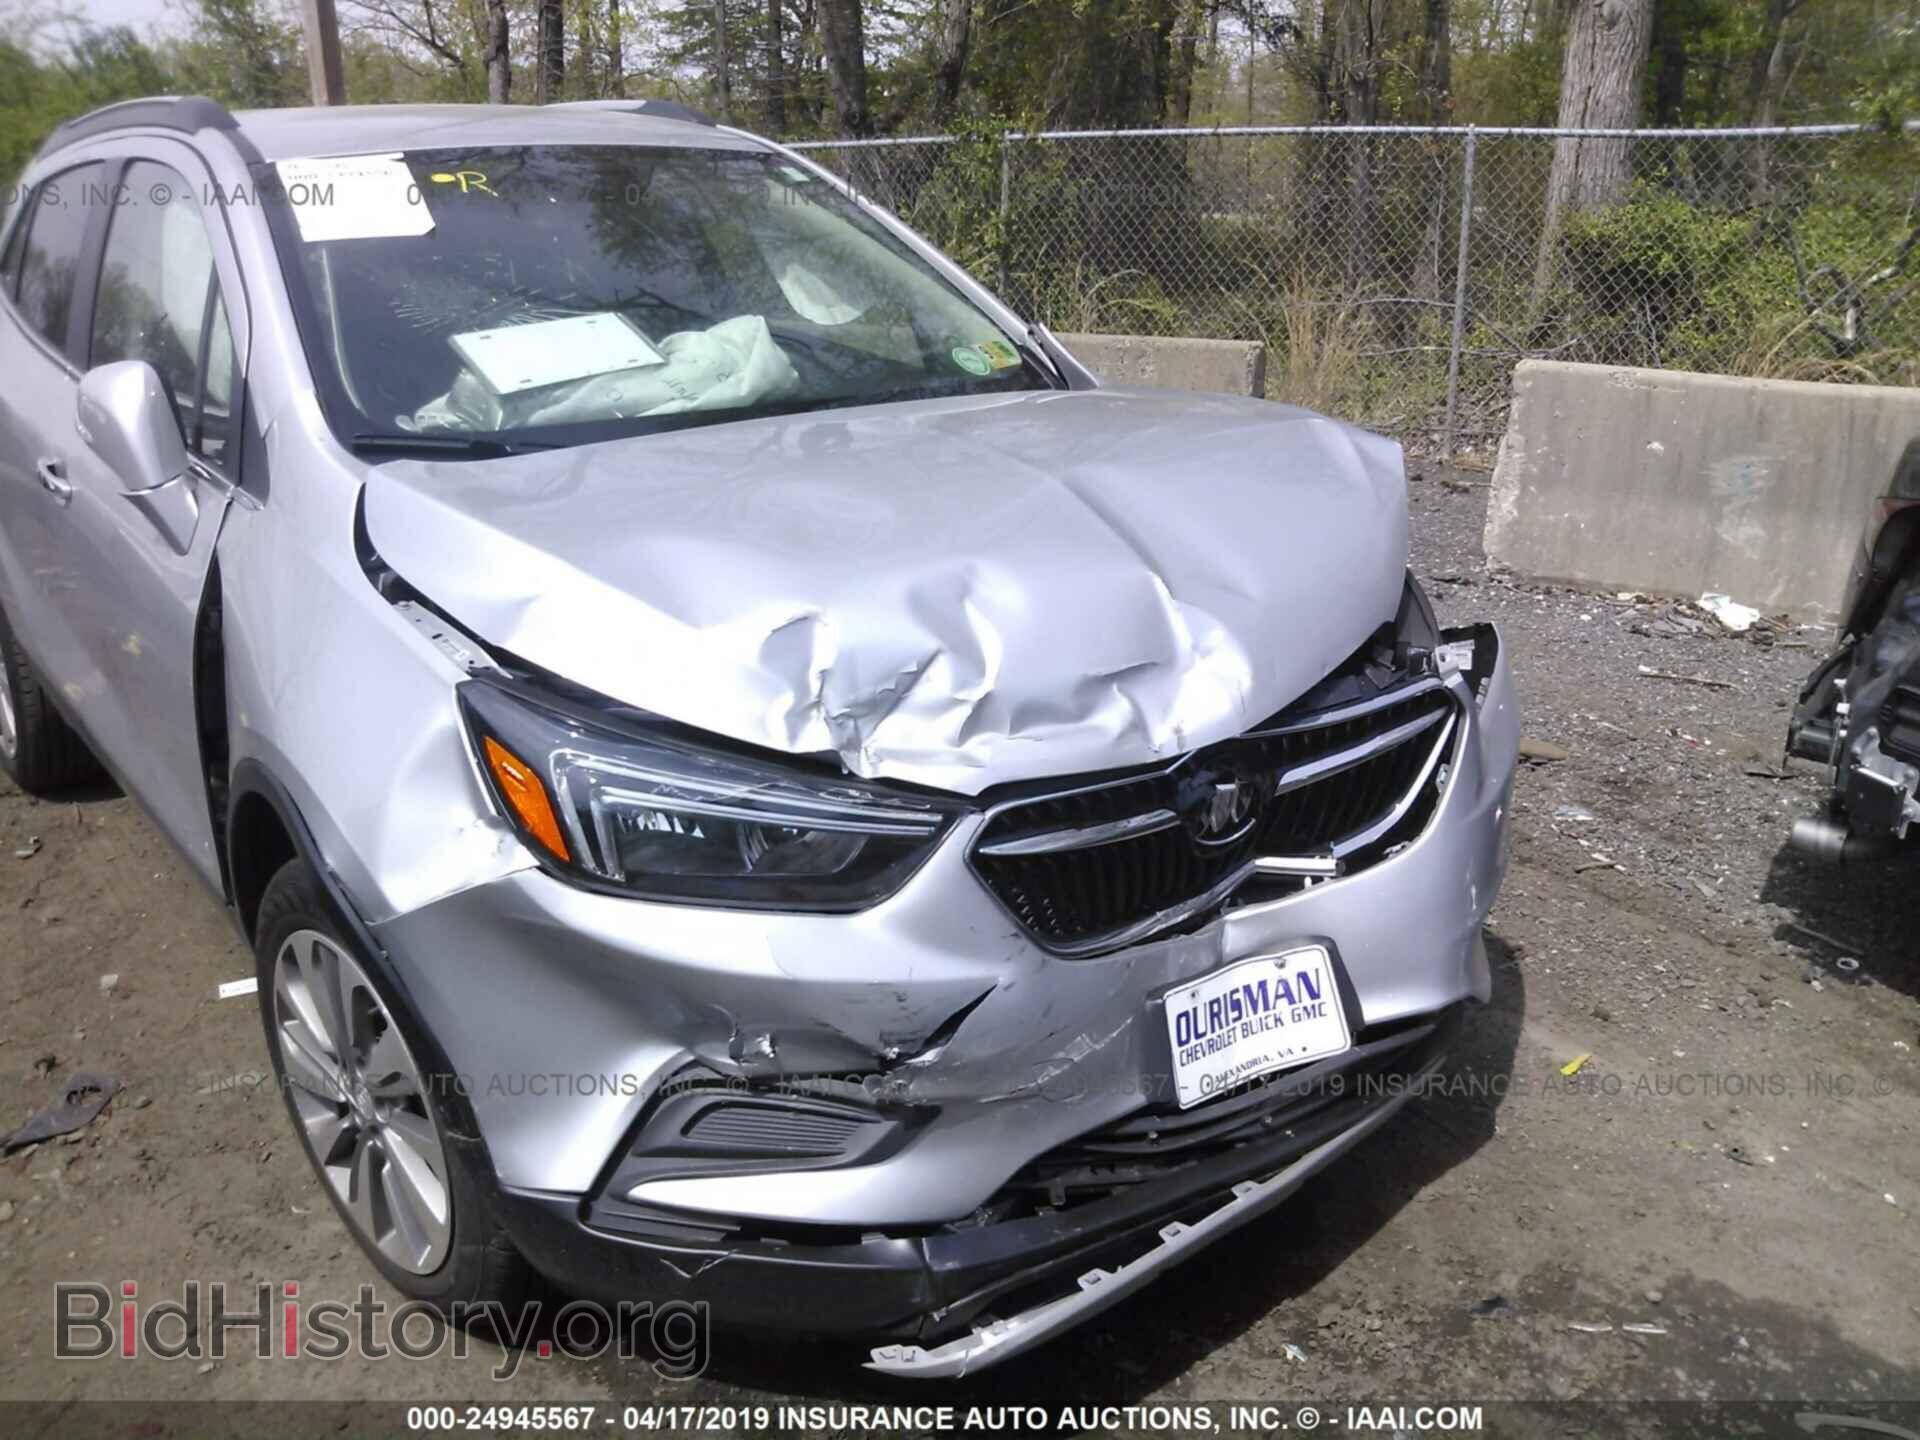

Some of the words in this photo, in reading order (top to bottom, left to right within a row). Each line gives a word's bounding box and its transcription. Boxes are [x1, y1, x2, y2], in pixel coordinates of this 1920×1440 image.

[1175, 967, 1322, 1048] OURISMAN
[1179, 1026, 1238, 1067] CHEVROLET
[1240, 1012, 1285, 1040] BUICK
[1291, 1001, 1327, 1024] GMC
